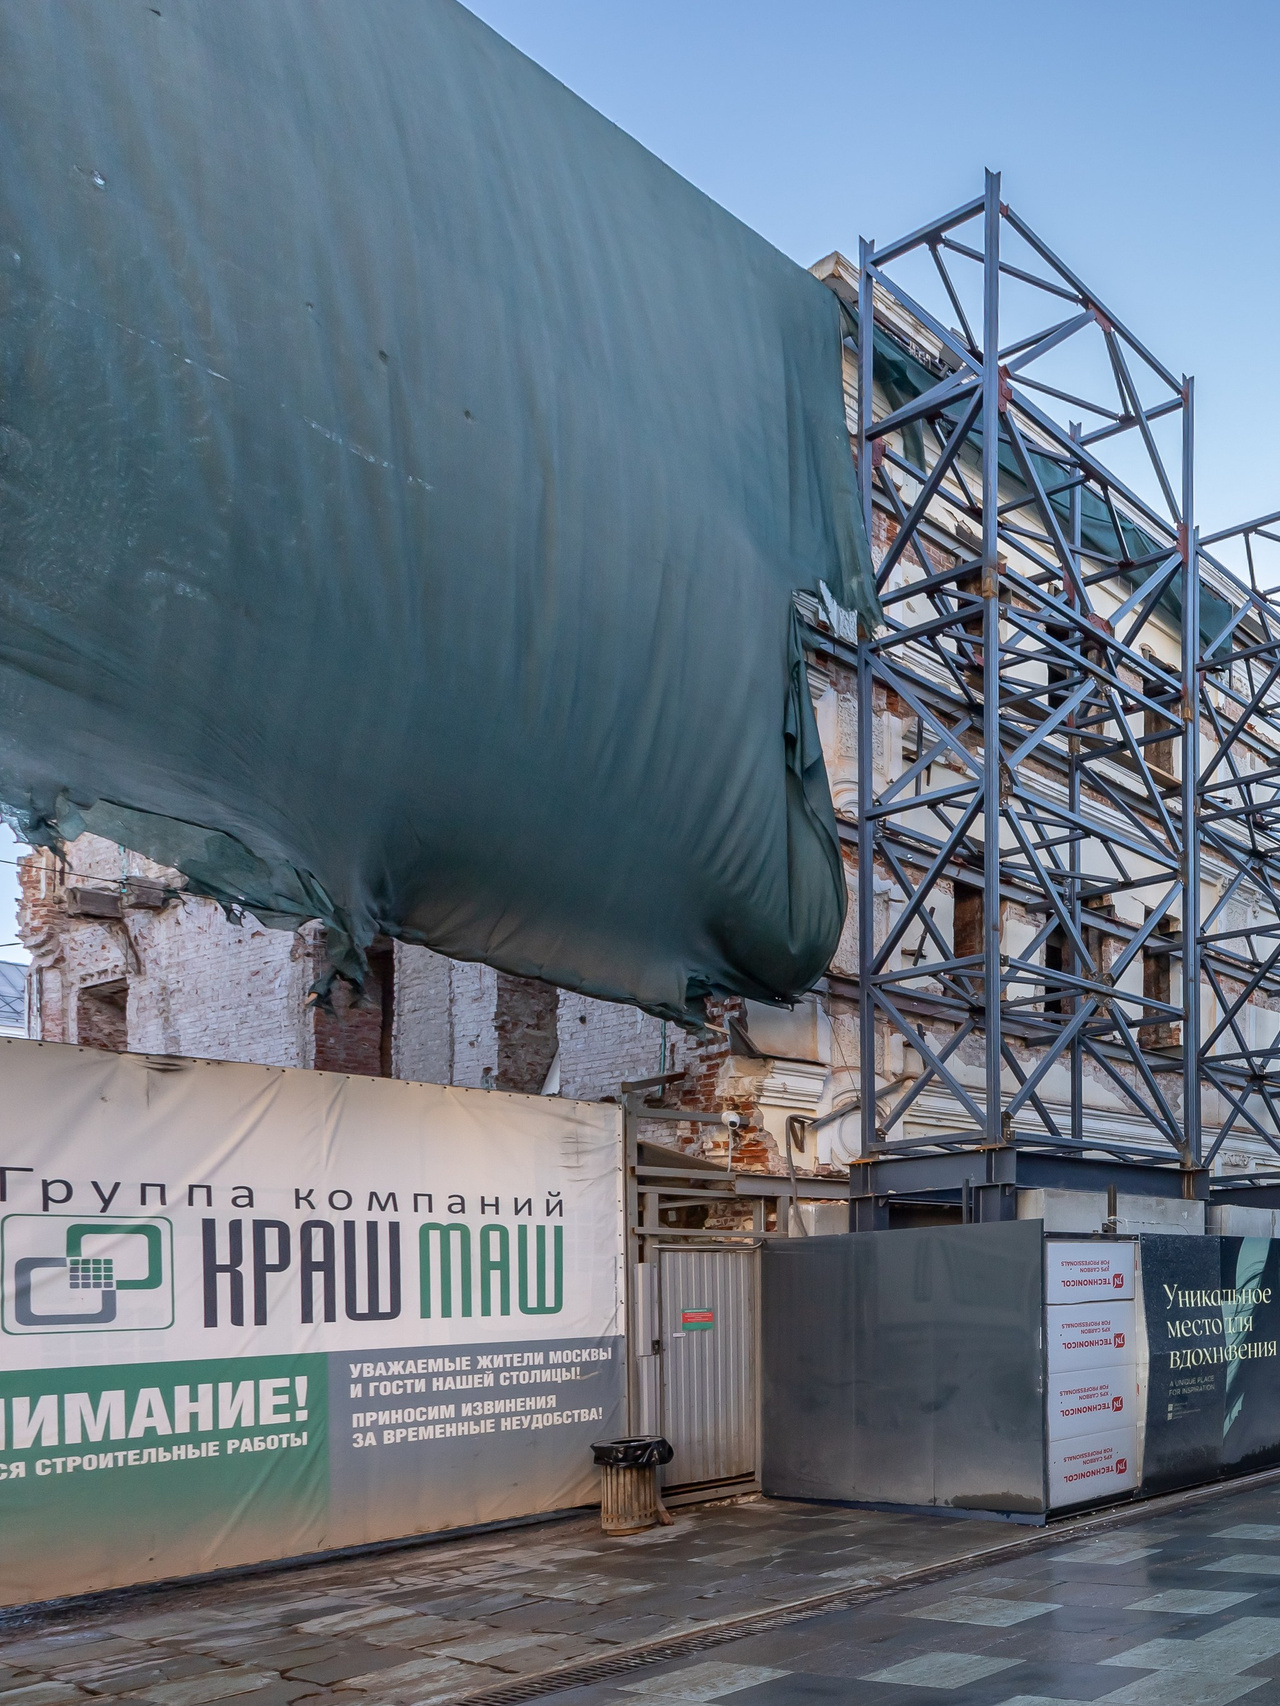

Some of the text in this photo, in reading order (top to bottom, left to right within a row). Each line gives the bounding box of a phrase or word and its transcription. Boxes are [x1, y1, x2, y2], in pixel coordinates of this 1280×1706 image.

[0, 1166, 563, 1217] Группа компаний
[1061, 1278, 1111, 1287] TECHNONICOL
[1163, 1284, 1272, 1310] Уникальное
[1167, 1318, 1223, 1338] место
[1062, 1339, 1112, 1349] TECHNONICOL
[1170, 1340, 1277, 1370] вдохновения
[349, 1347, 612, 1379] УВАЖАЕМЫЕ ЖИТЕЛИ МОСКВЫ
[350, 1367, 581, 1398] И ГОСТИ НАШЕЙ СТОЛИЦЫ!
[0, 1376, 308, 1450] ИМАНИЕ!
[352, 1394, 557, 1428] ПРИНОСИМ ИЗВИНЕНИЯ
[1060, 1402, 1110, 1417] TECHNONICOL
[352, 1407, 603, 1448] ЗА ВРЕМЕННЫЕ НЕУДОБСТВА!
[35, 1441, 220, 1476] СТРОИТЕЛЬНЫЕ
[226, 1432, 308, 1454] РАБОТЫ
[1064, 1466, 1114, 1482] TECHNONICOL
